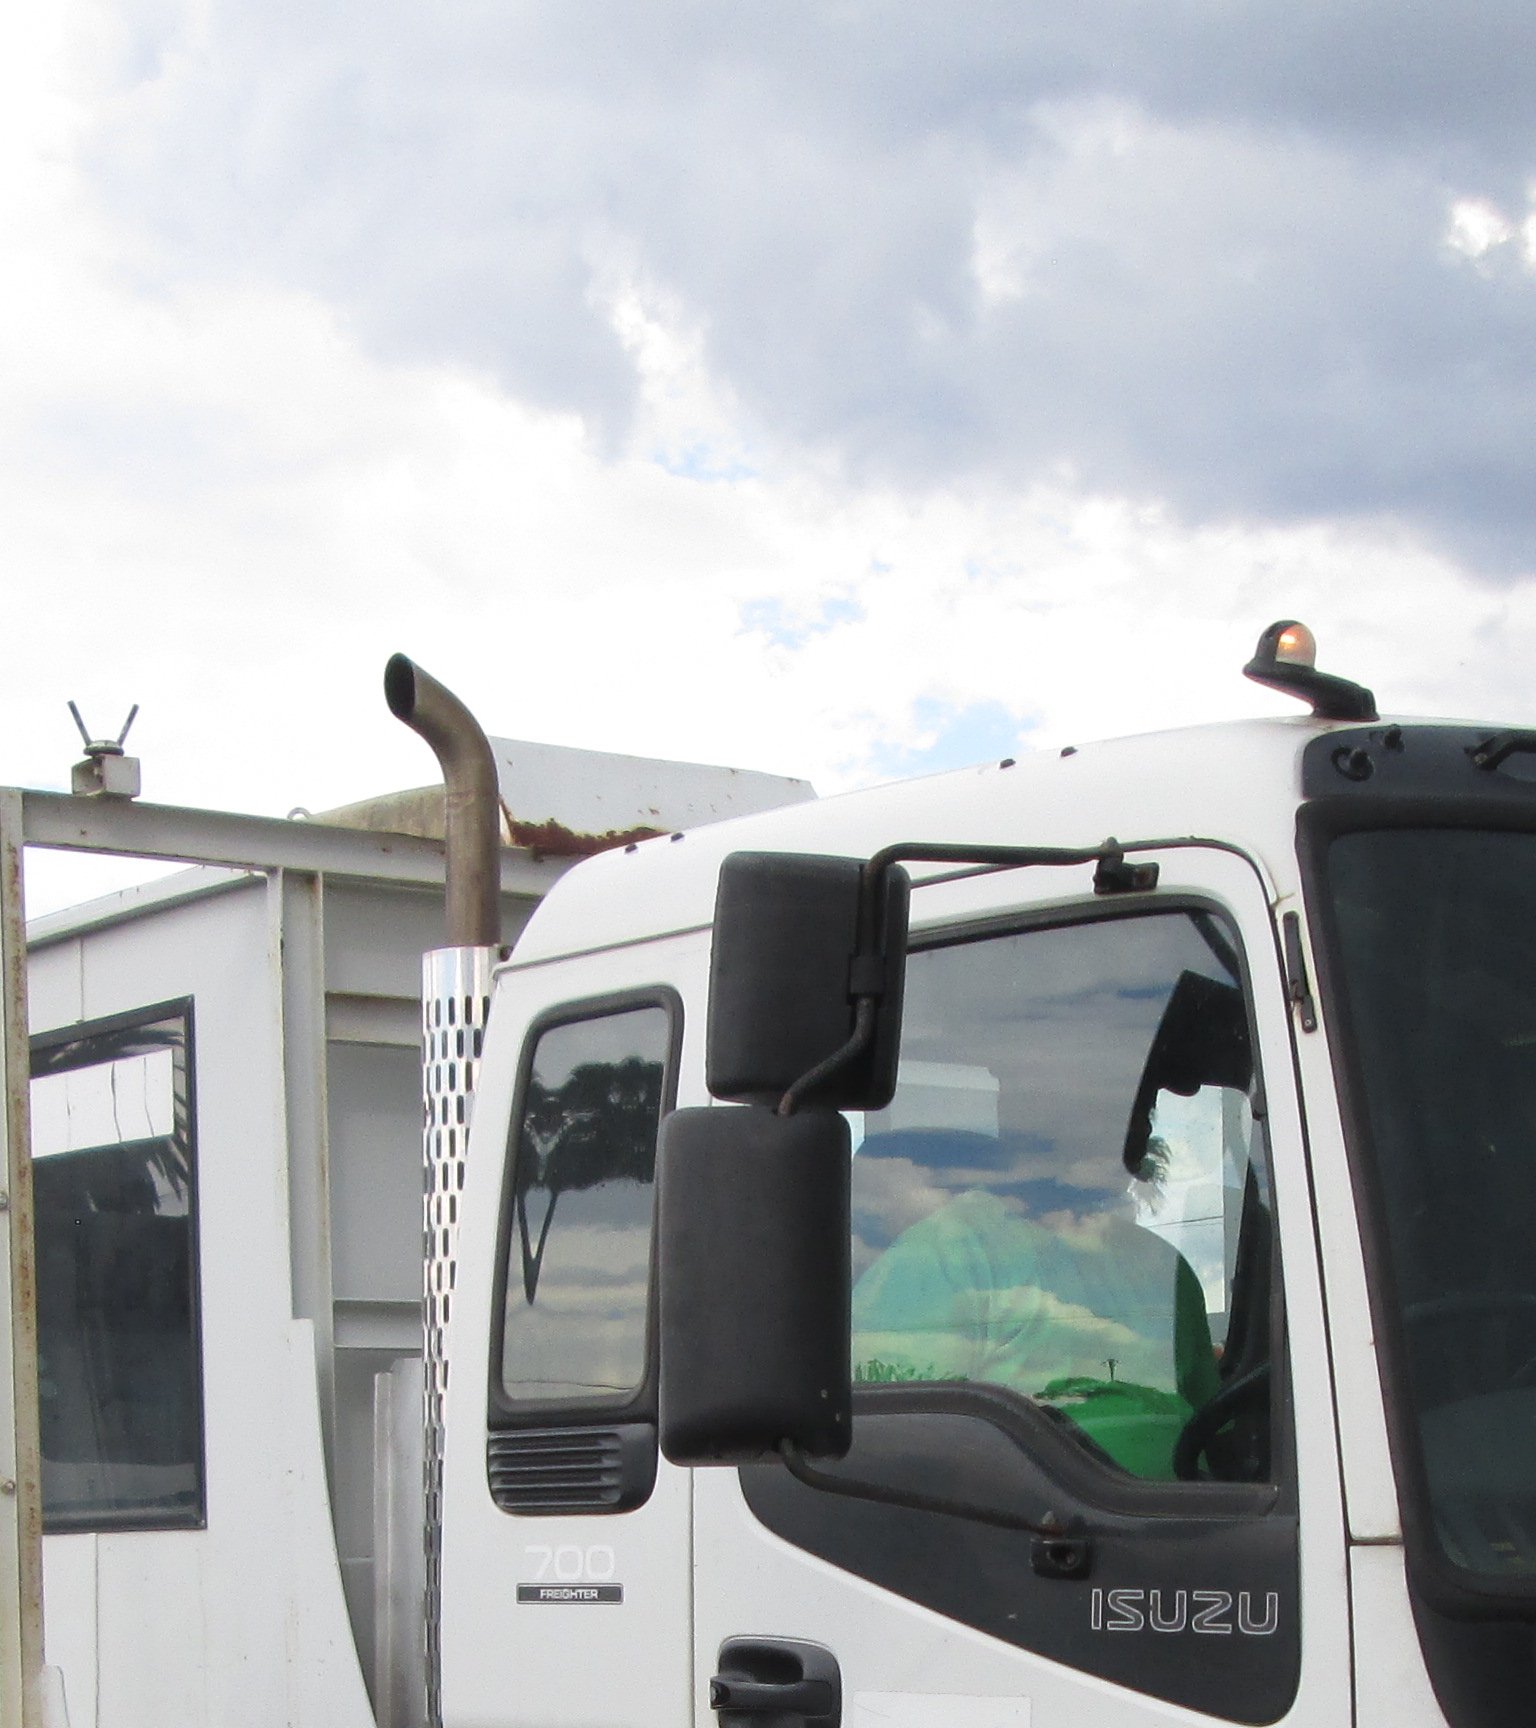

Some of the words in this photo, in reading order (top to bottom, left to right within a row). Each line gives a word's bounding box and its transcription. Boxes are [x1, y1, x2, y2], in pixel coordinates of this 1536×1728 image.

[524, 1544, 616, 1580] 700
[539, 1588, 599, 1600] FREIGHTER
[1089, 1586, 1280, 1636] ISUZU
